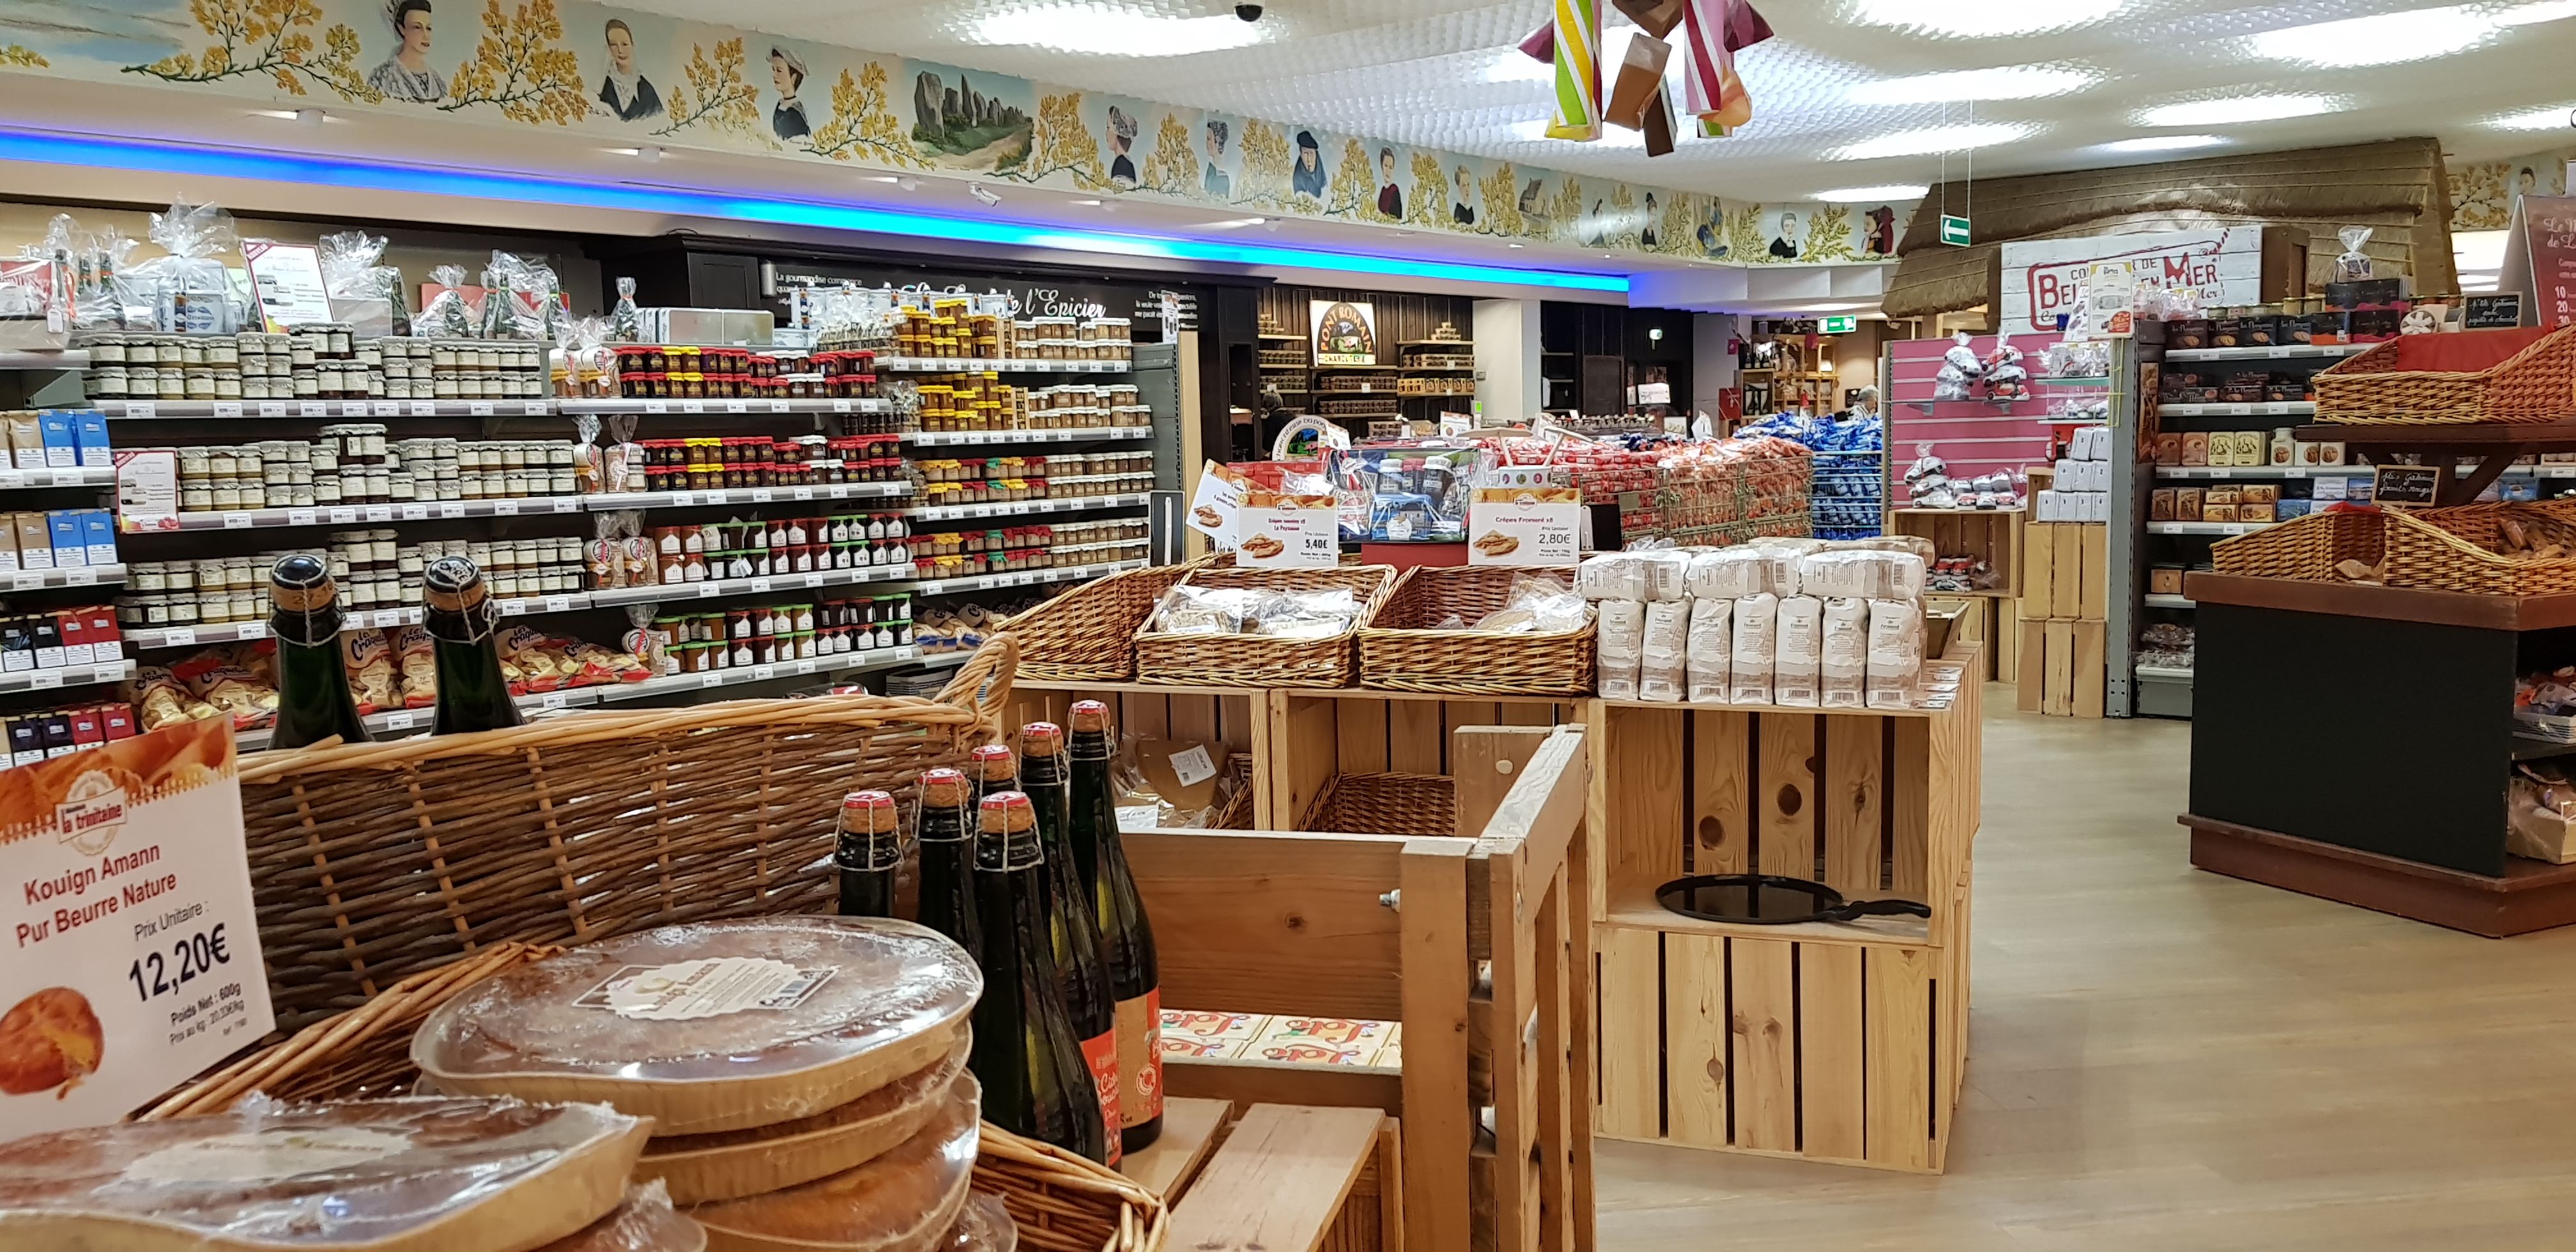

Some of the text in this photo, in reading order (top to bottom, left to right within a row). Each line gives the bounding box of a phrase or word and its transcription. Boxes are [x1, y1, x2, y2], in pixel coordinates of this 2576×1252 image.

[2555, 286, 2566, 299] 10
[2556, 300, 2568, 313] 20
[1305, 539, 1328, 549] 5,40€
[1538, 533, 1571, 545] 2,80€
[76, 804, 122, 829] trinitaine
[24, 844, 160, 905] Kouign Amann
[16, 873, 176, 948] Pur Beurre Nature
[134, 920, 157, 942] Prix
[160, 903, 203, 930] Unitaire
[130, 922, 230, 1002] 12,20€
[170, 1004, 197, 1027] Poids
[198, 994, 213, 1012] Net
